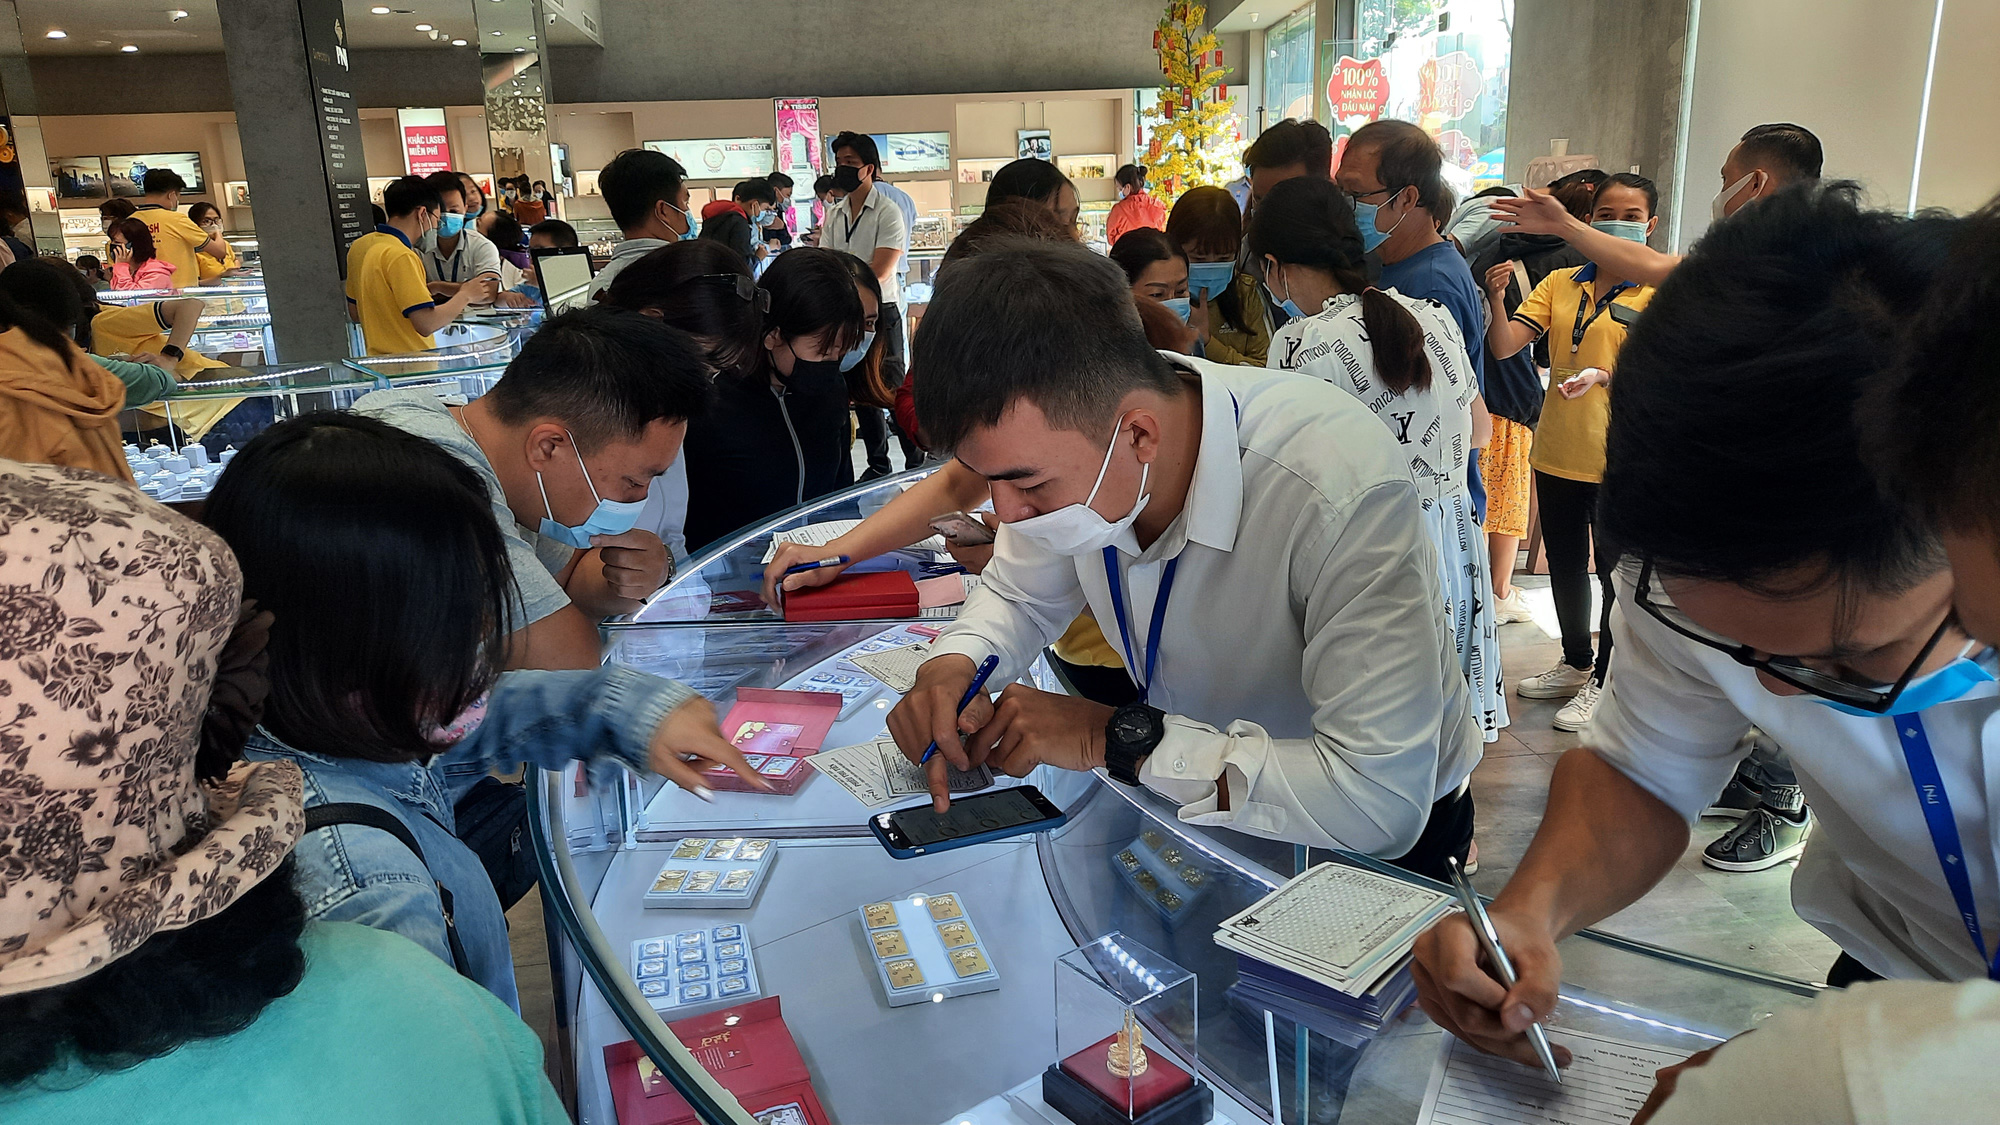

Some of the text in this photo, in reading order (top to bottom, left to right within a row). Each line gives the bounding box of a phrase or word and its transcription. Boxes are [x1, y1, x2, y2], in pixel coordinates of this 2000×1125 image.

[335, 45, 349, 72] PNJ
[1342, 67, 1379, 87] 100%
[407, 133, 446, 144] KHẮC LASER
[1922, 785, 1940, 805] PNJ
